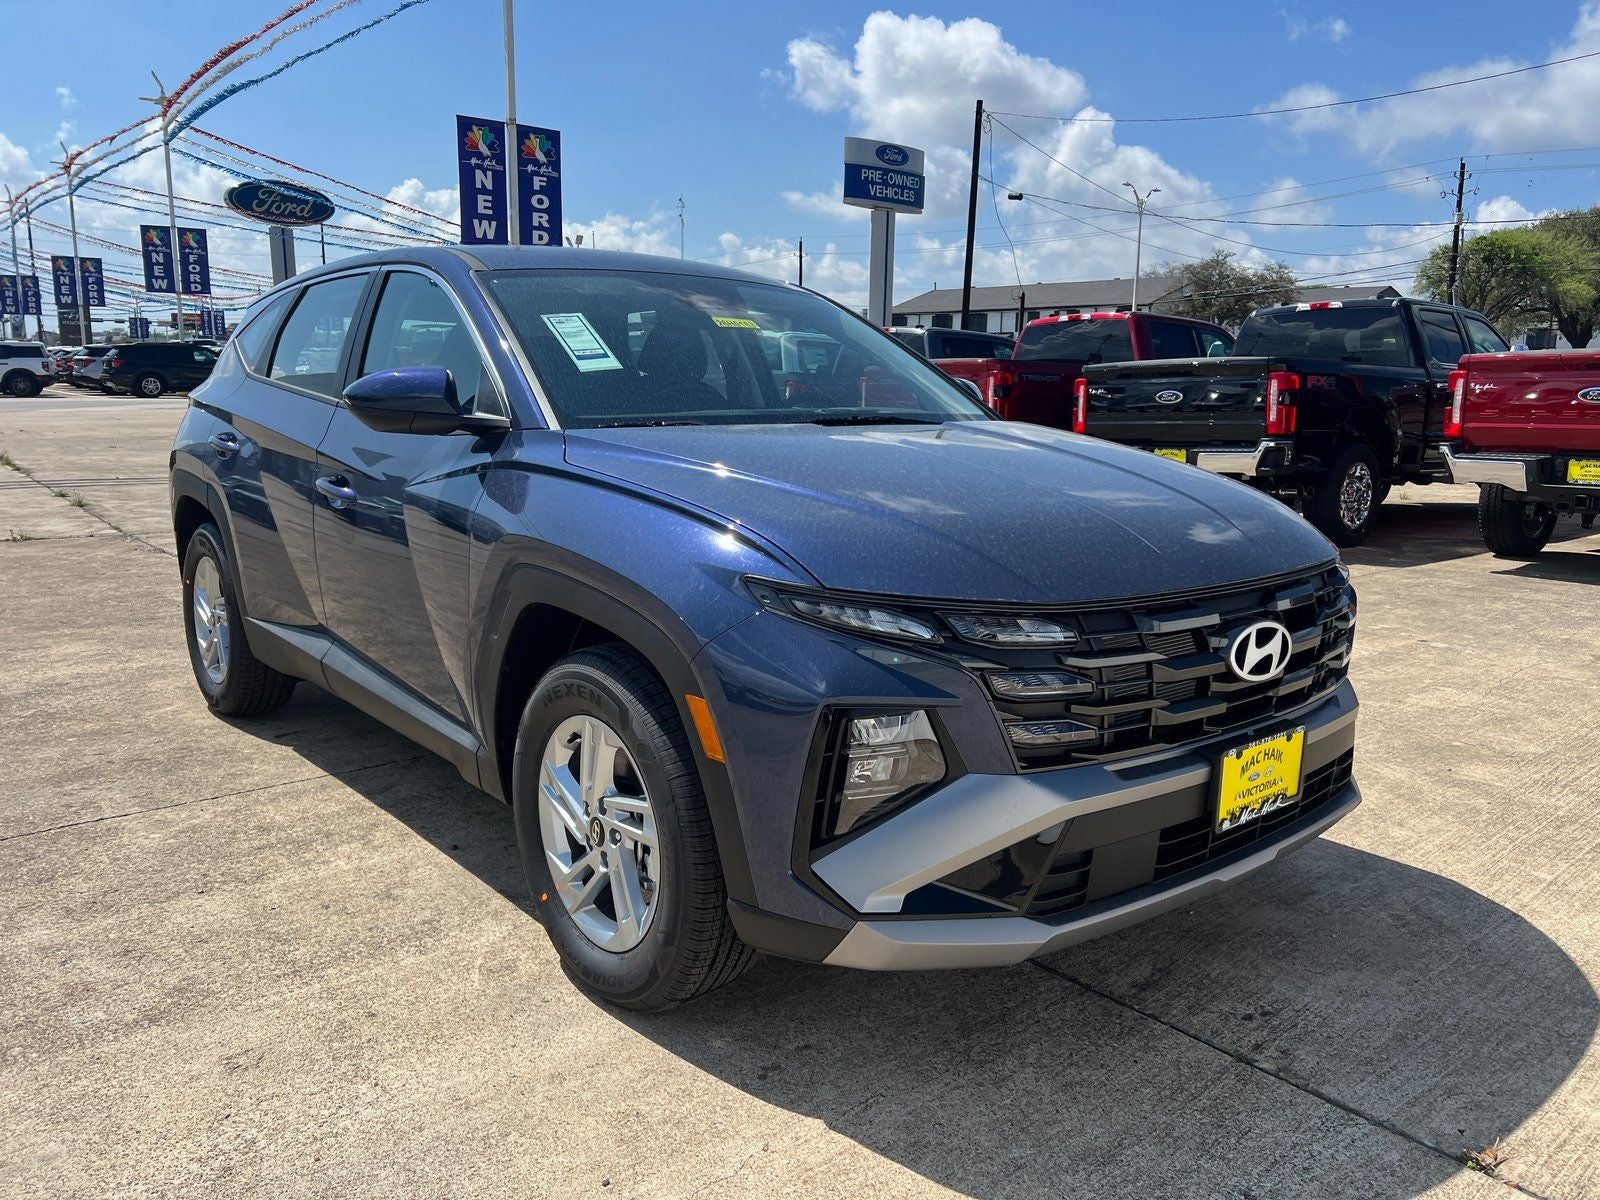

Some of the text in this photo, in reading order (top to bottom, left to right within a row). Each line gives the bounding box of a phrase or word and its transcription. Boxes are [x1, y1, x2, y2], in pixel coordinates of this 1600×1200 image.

[884, 148, 904, 162] Ford
[861, 169, 920, 189] PRE-OWNED
[252, 187, 313, 217] Ford
[472, 169, 497, 240] NEW
[869, 184, 915, 202] VEHICLES
[530, 176, 550, 245] FORD
[151, 252, 168, 290] NEW
[188, 254, 202, 291] FORD
[5, 290, 16, 313] NEW
[27, 290, 37, 314] FORD
[60, 275, 73, 304] NEW
[88, 276, 99, 305] FORD
[1307, 375, 1336, 388] FX4
[543, 683, 603, 708] NEXEN
[1240, 747, 1284, 779] MAC HAIK
[1239, 806, 1260, 825] Mac
